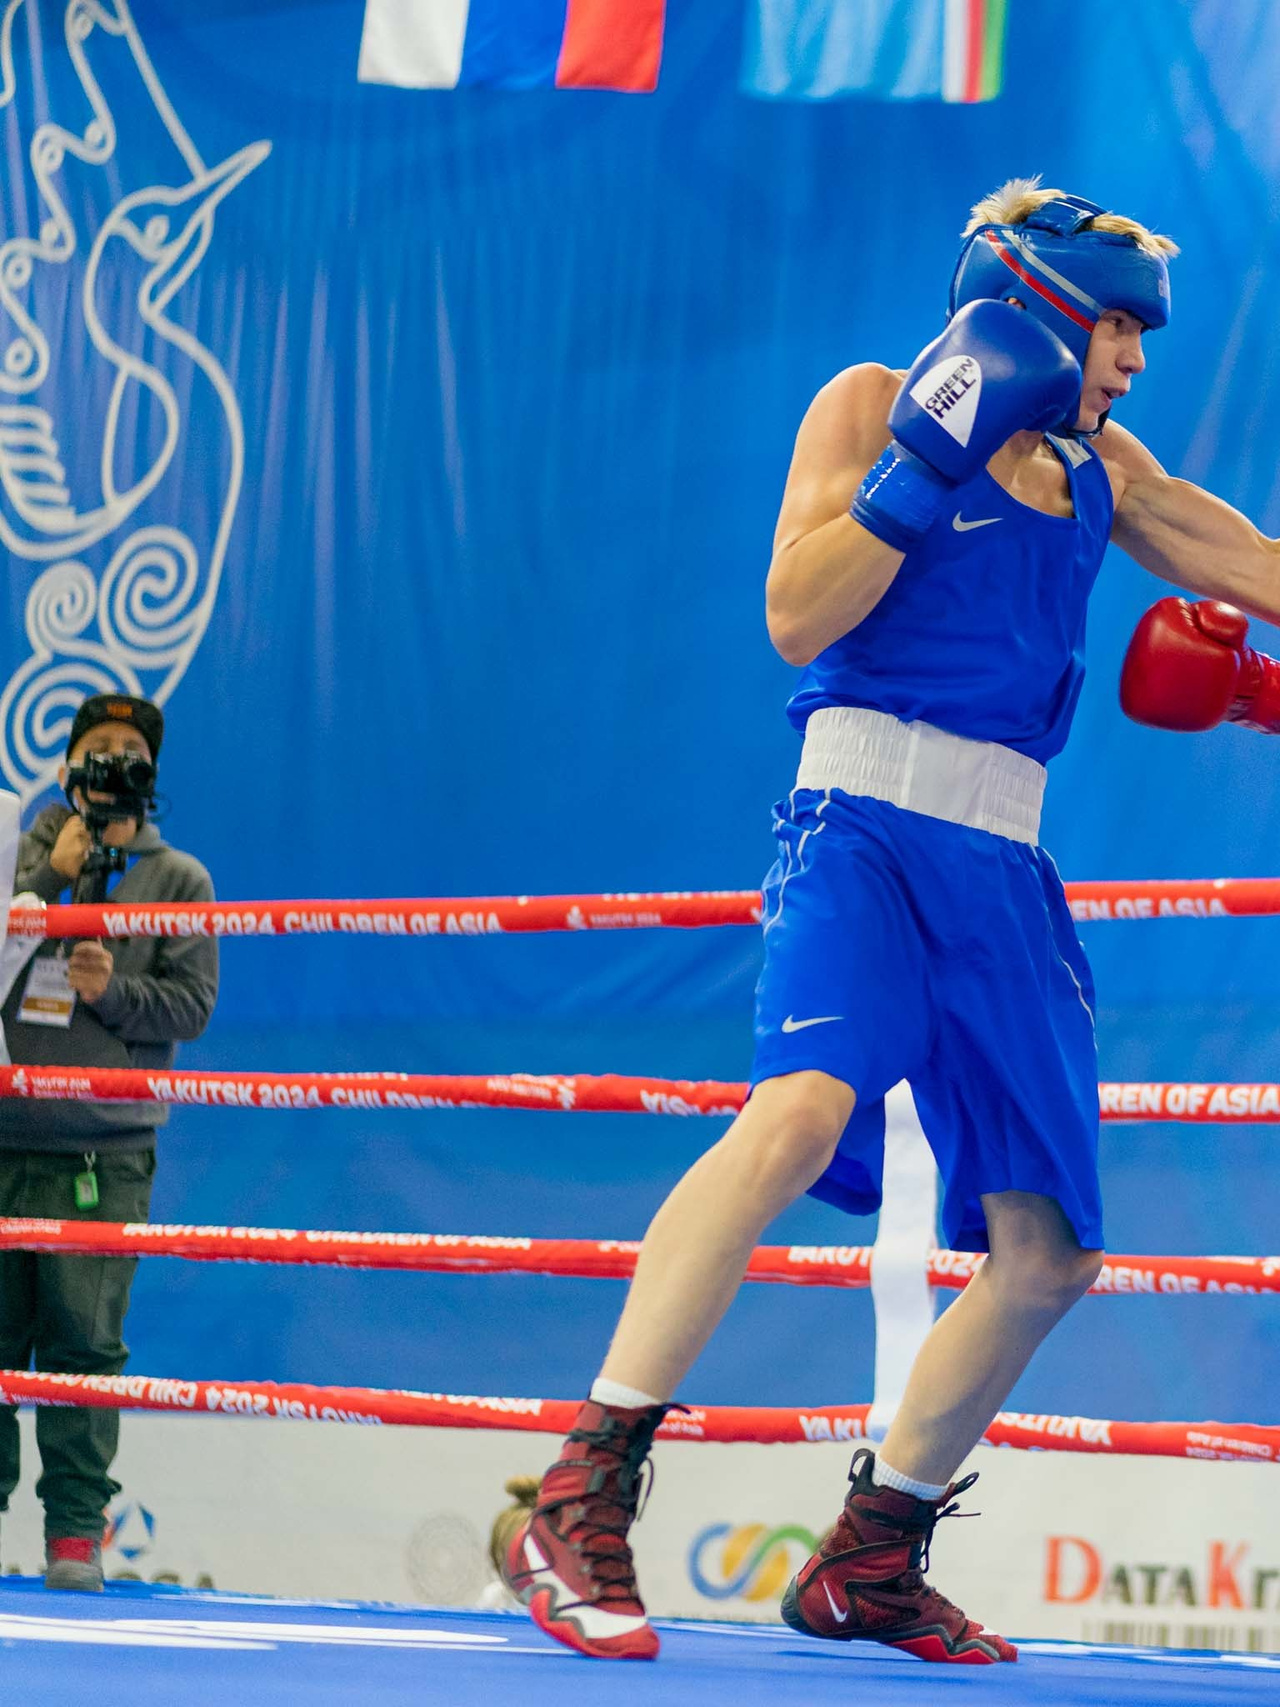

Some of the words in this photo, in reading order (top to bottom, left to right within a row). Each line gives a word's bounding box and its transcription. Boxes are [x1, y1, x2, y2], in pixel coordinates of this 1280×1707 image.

[925, 358, 975, 410] GREEN
[932, 376, 977, 420] HILL
[103, 912, 207, 937] YAKUTSK
[211, 911, 276, 935] 2024
[283, 911, 406, 935] CHILDREN
[409, 911, 440, 935] OF
[445, 912, 501, 935] ASIA
[147, 1077, 254, 1106] YAKUTSK
[258, 1083, 322, 1108] 2024
[1165, 1085, 1204, 1115] OF
[205, 1386, 272, 1418] 2024
